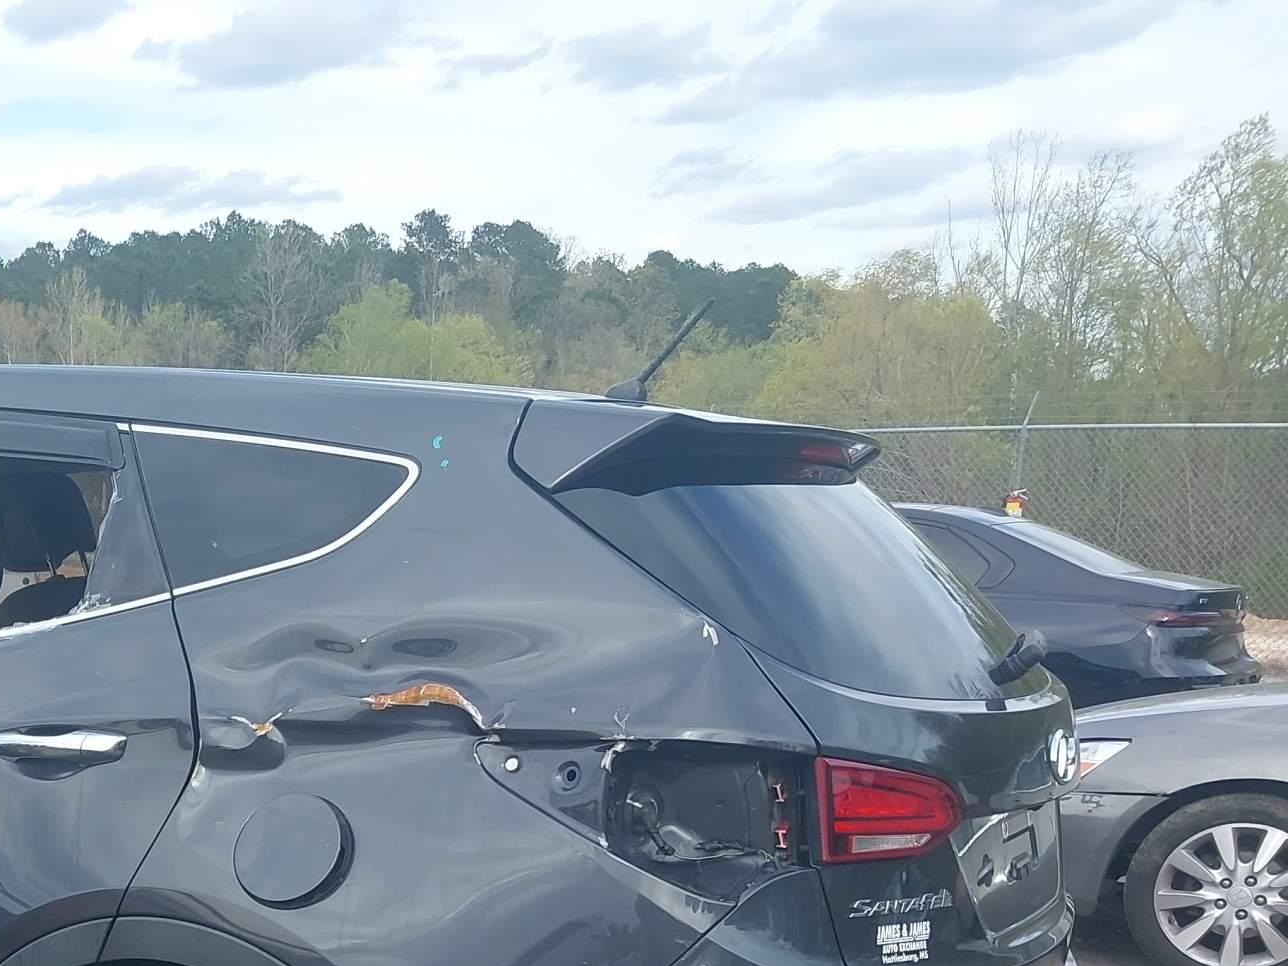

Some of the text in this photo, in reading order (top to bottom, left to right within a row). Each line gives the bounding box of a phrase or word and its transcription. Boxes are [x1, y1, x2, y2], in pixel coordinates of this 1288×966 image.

[877, 921, 931, 940] JAMES & JAMES
[882, 941, 927, 954] AUTO EXCHANGE
